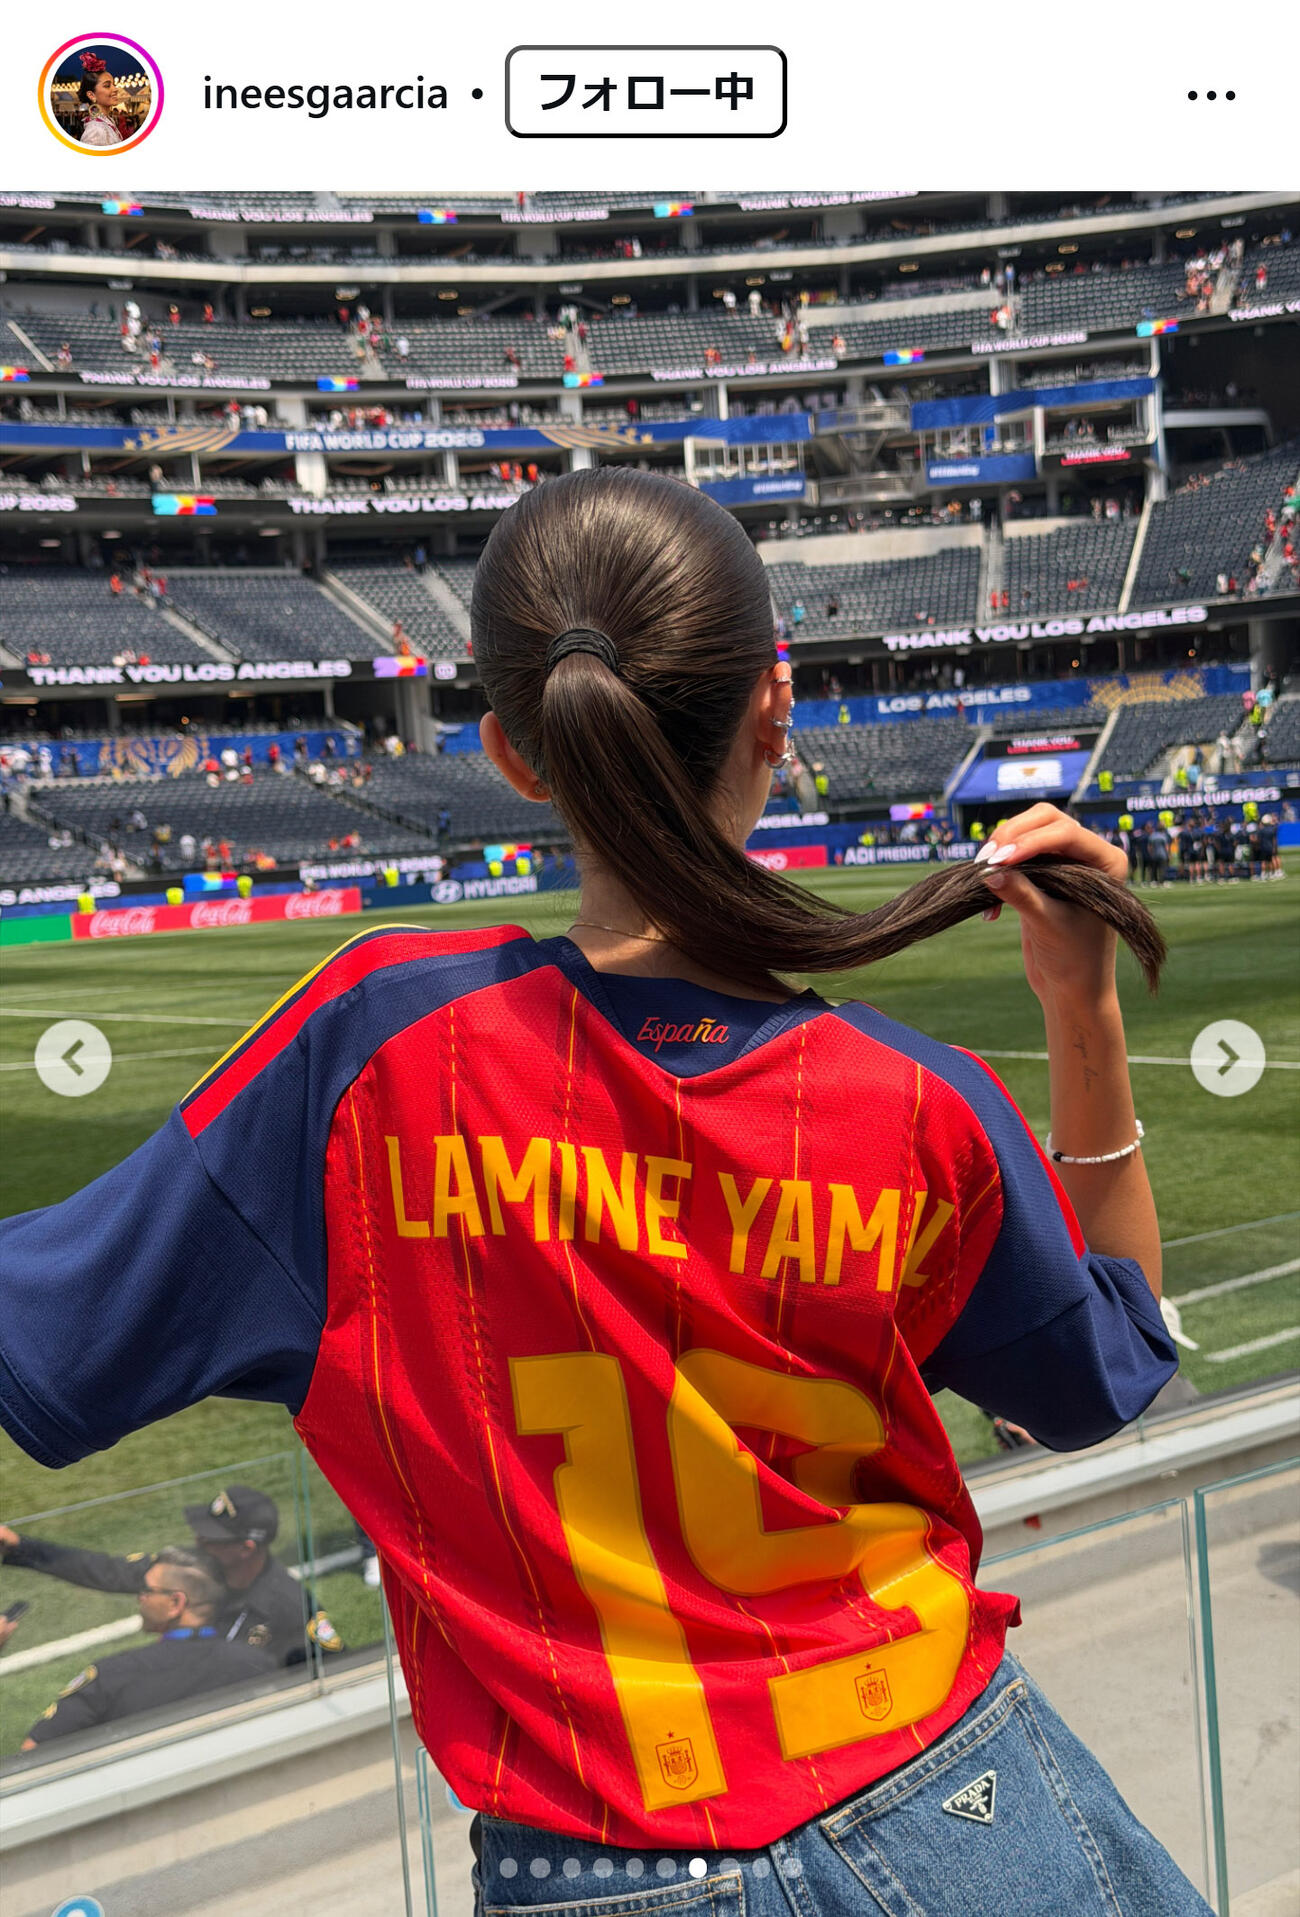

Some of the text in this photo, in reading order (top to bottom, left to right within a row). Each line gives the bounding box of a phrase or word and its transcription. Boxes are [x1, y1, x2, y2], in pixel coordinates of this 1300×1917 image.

[285, 432, 323, 450] FIFA
[324, 432, 387, 450] WORLD
[388, 432, 423, 449] CUP
[289, 497, 370, 514] THANK
[371, 496, 421, 513] YOU
[423, 496, 469, 512] LOS
[883, 605, 1208, 652] THANK YOU LOS ANGELES
[27, 659, 352, 685] THANK YOU LOS ANGELES
[877, 686, 1032, 714] LOS ANGELES
[1126, 796, 1155, 811] FIFA
[1155, 792, 1203, 809] WORLD
[1204, 790, 1230, 806] CUP
[843, 845, 876, 865] ADI
[463, 875, 538, 899] HYUNDAI
[190, 898, 252, 929] Coca-Cola
[284, 889, 345, 920] Coca-Cola
[89, 906, 157, 939] Coca-Cola
[637, 1017, 730, 1053] España
[384, 1134, 693, 1260] LAMINE
[508, 1348, 970, 1812] 19
[954, 1780, 991, 1808] PRADA
